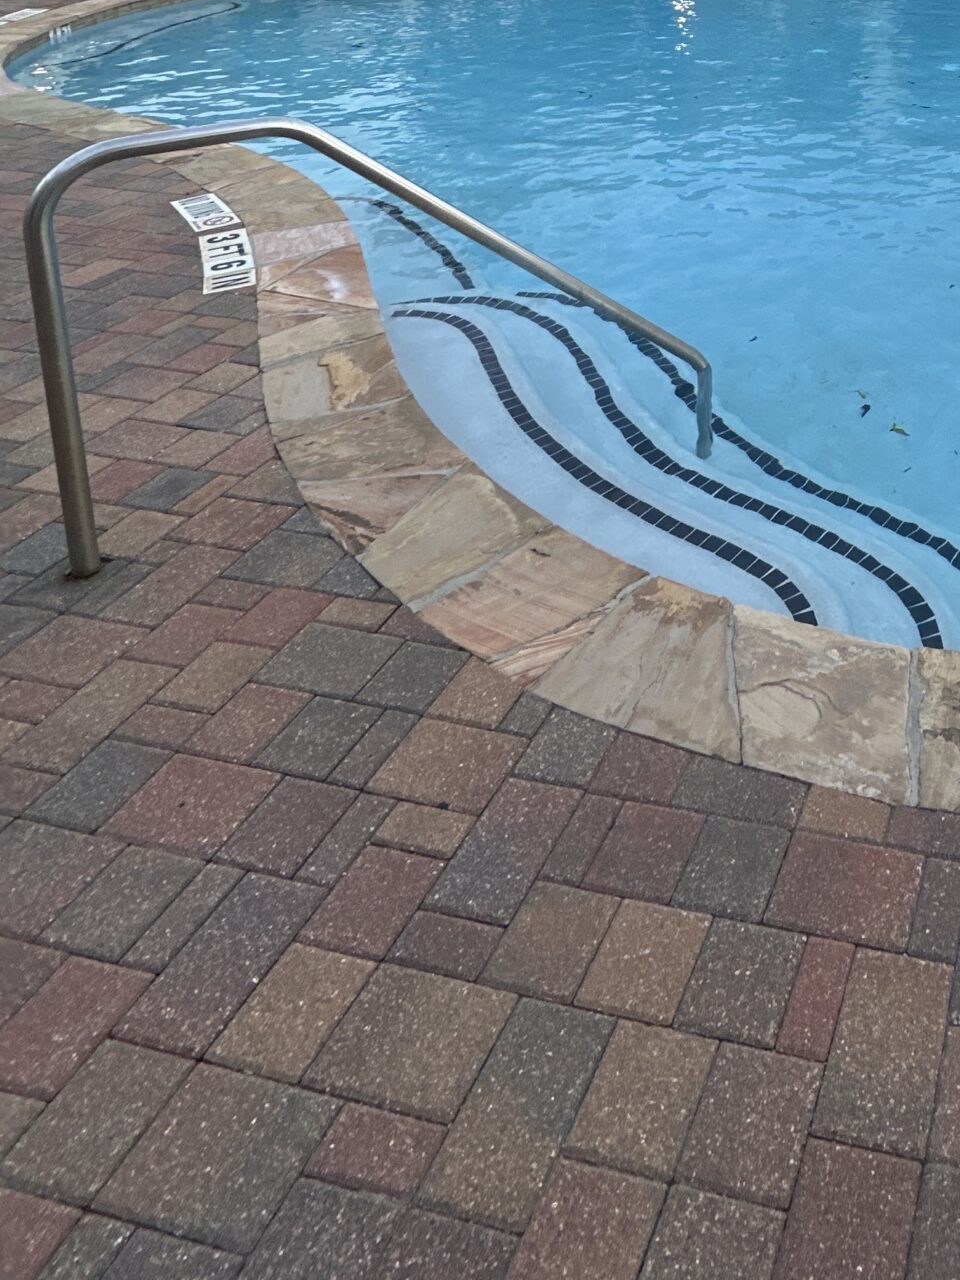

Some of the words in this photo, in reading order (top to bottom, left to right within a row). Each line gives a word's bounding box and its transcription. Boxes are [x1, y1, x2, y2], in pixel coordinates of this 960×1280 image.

[207, 234, 240, 243] 3
[208, 243, 245, 258] FT
[210, 260, 246, 271] 6
[212, 272, 250, 289] IN
